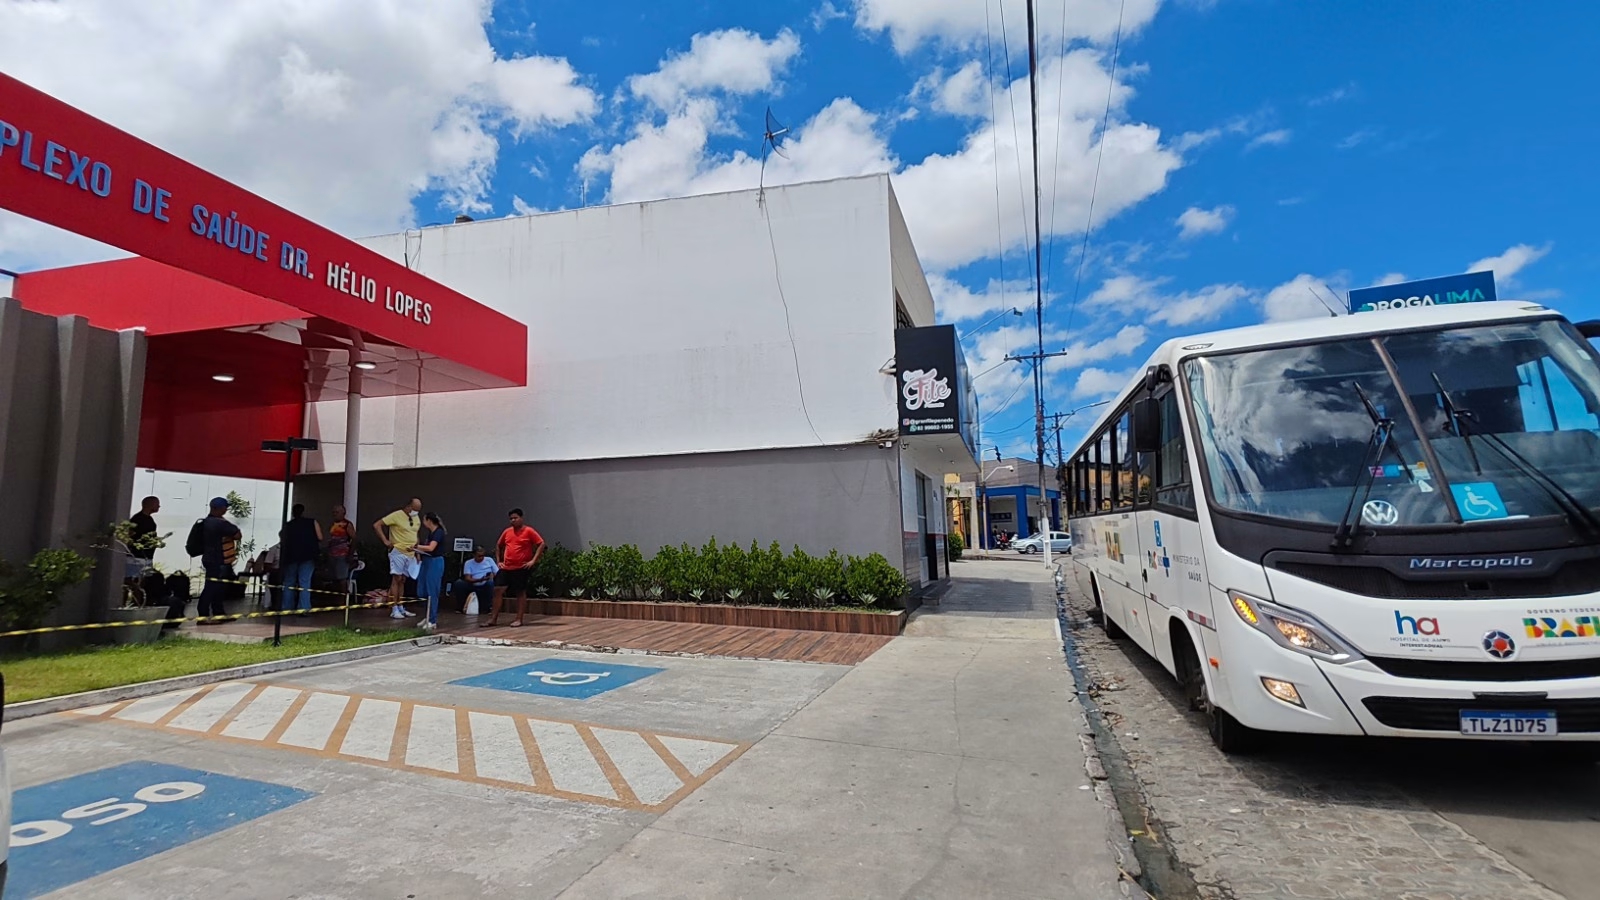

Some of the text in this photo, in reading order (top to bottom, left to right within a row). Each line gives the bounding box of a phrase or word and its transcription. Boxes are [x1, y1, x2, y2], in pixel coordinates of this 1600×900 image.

[0, 120, 432, 325] PLEXO DE SAÚDE DR. HÉLIO LOPES
[1410, 556, 1533, 569] Marcopolo
[1394, 610, 1440, 635] ha
[1469, 719, 1547, 733] TLZ1D75
